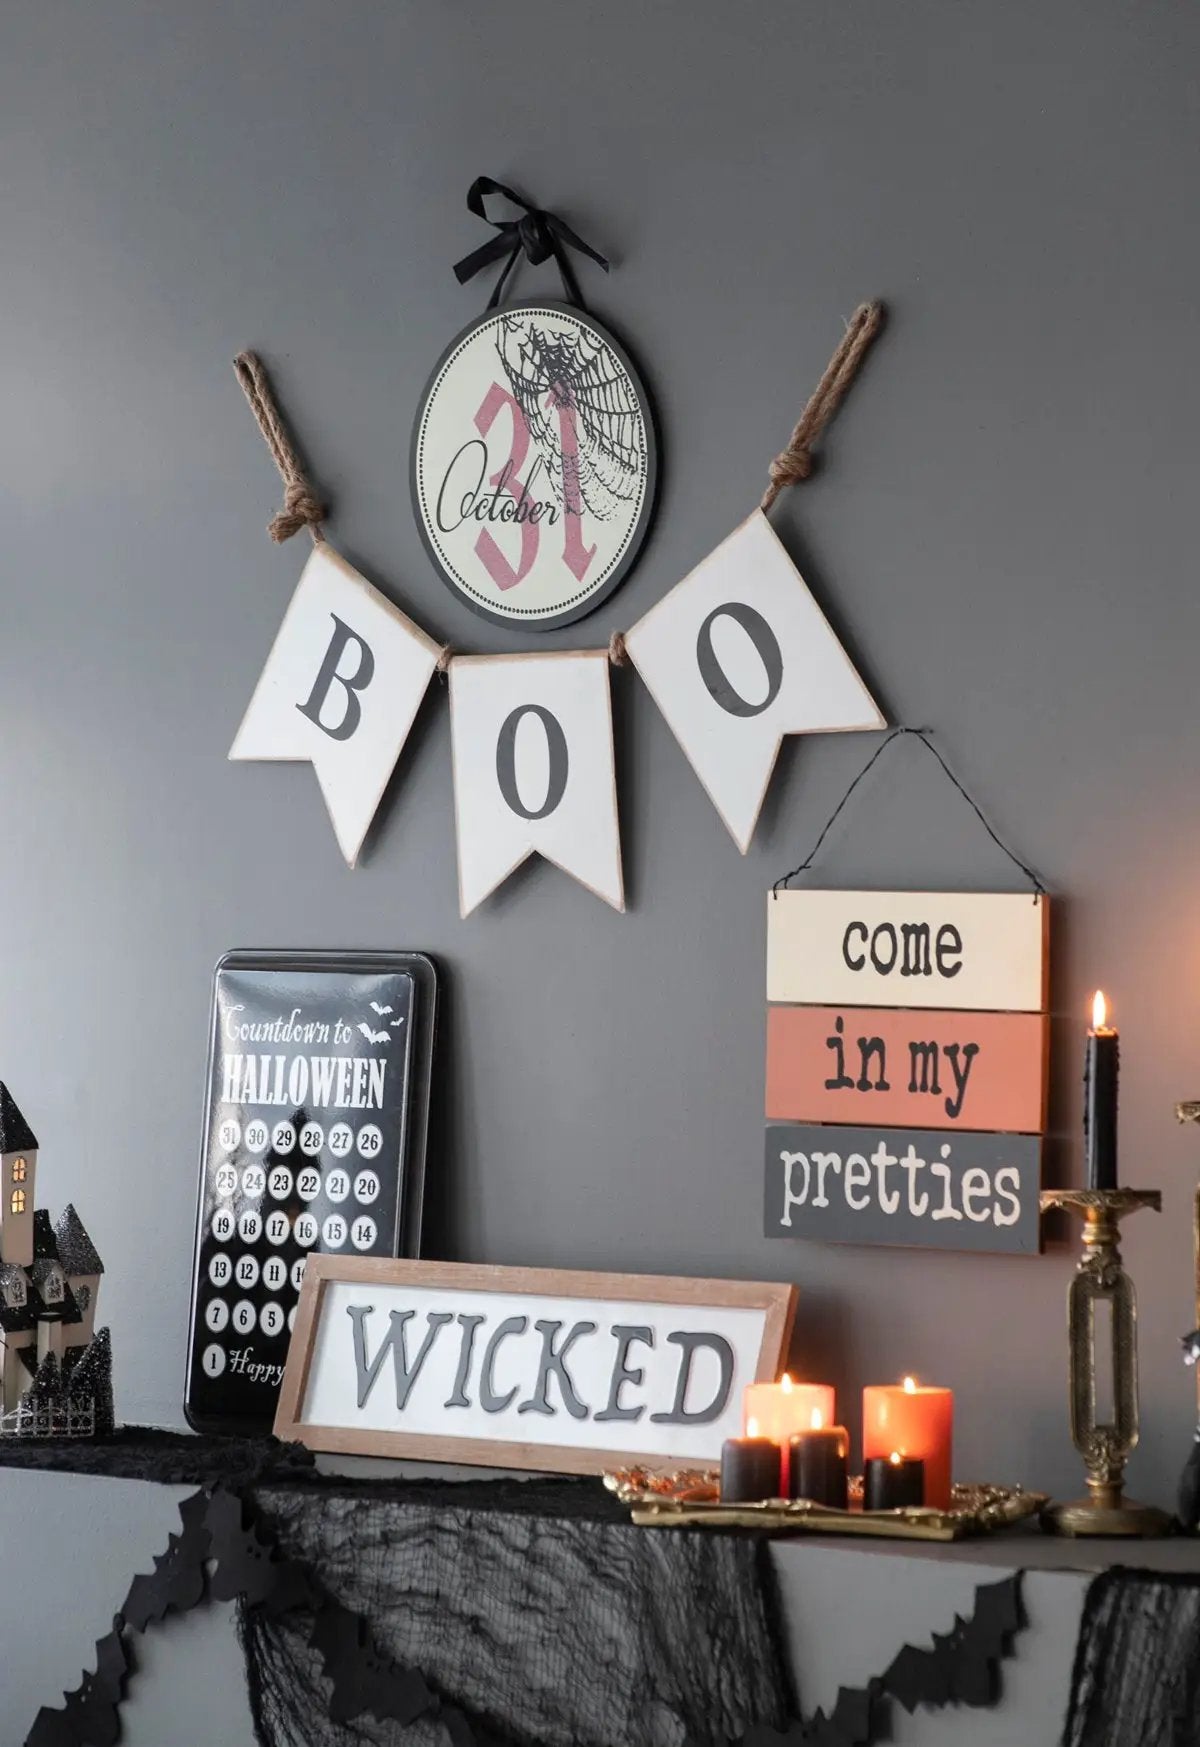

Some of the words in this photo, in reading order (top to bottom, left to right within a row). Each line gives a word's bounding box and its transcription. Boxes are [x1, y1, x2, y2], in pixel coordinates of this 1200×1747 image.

[436, 439, 560, 532] October
[473, 380, 597, 591] 31
[842, 921, 963, 978] come
[222, 1004, 329, 1043] Countdown
[334, 1017, 352, 1044] to
[221, 1054, 387, 1109] HALLOWEEN
[824, 1016, 890, 1092] in
[908, 1040, 980, 1119] my
[223, 1127, 236, 1145] 31
[248, 1128, 264, 1145] 30
[276, 1130, 292, 1146] 29
[304, 1131, 320, 1147] 28
[332, 1132, 349, 1149] 27
[361, 1133, 378, 1150] 26
[218, 1171, 235, 1189] 25
[246, 1173, 262, 1190] 24
[273, 1174, 289, 1191] 23
[301, 1175, 317, 1192] 22
[330, 1177, 344, 1194] 21
[358, 1178, 376, 1195] 20
[779, 1140, 1021, 1226] pretties
[217, 1217, 230, 1234] 19
[243, 1219, 256, 1235] 18
[271, 1220, 285, 1236] 17
[299, 1221, 313, 1238] 16
[328, 1223, 342, 1240] 15
[357, 1225, 372, 1241] 14
[214, 1261, 227, 1278] 13
[240, 1263, 253, 1280] 12
[269, 1265, 280, 1281] 11
[213, 1307, 220, 1323] 7
[240, 1309, 248, 1325] 6
[268, 1311, 276, 1327] 5
[211, 1353, 217, 1370] 1
[229, 1347, 286, 1386] Happy
[346, 1305, 735, 1425] WICKED
